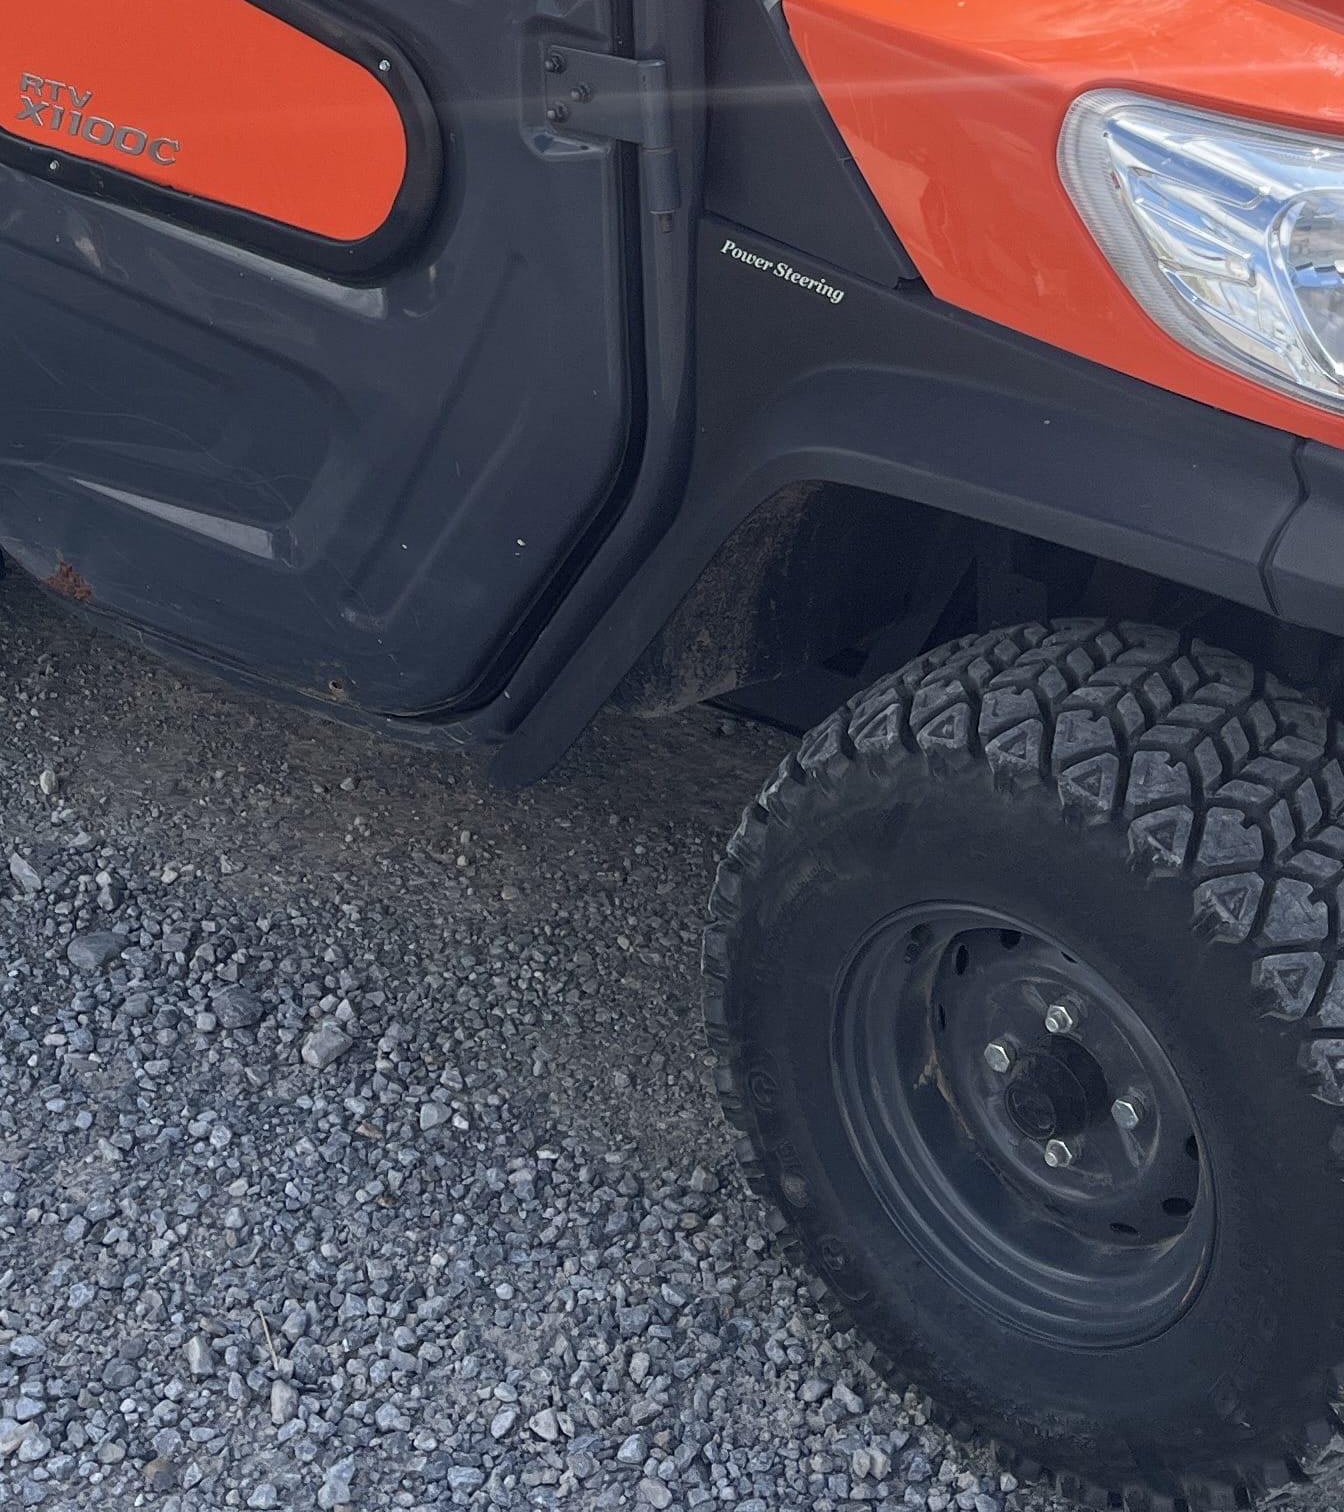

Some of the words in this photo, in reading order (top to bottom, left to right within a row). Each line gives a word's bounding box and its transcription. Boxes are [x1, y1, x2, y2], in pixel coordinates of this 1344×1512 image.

[20, 72, 93, 108] RTV
[16, 94, 181, 166] X1100C
[720, 239, 774, 271] Power
[772, 262, 845, 304] Steering
